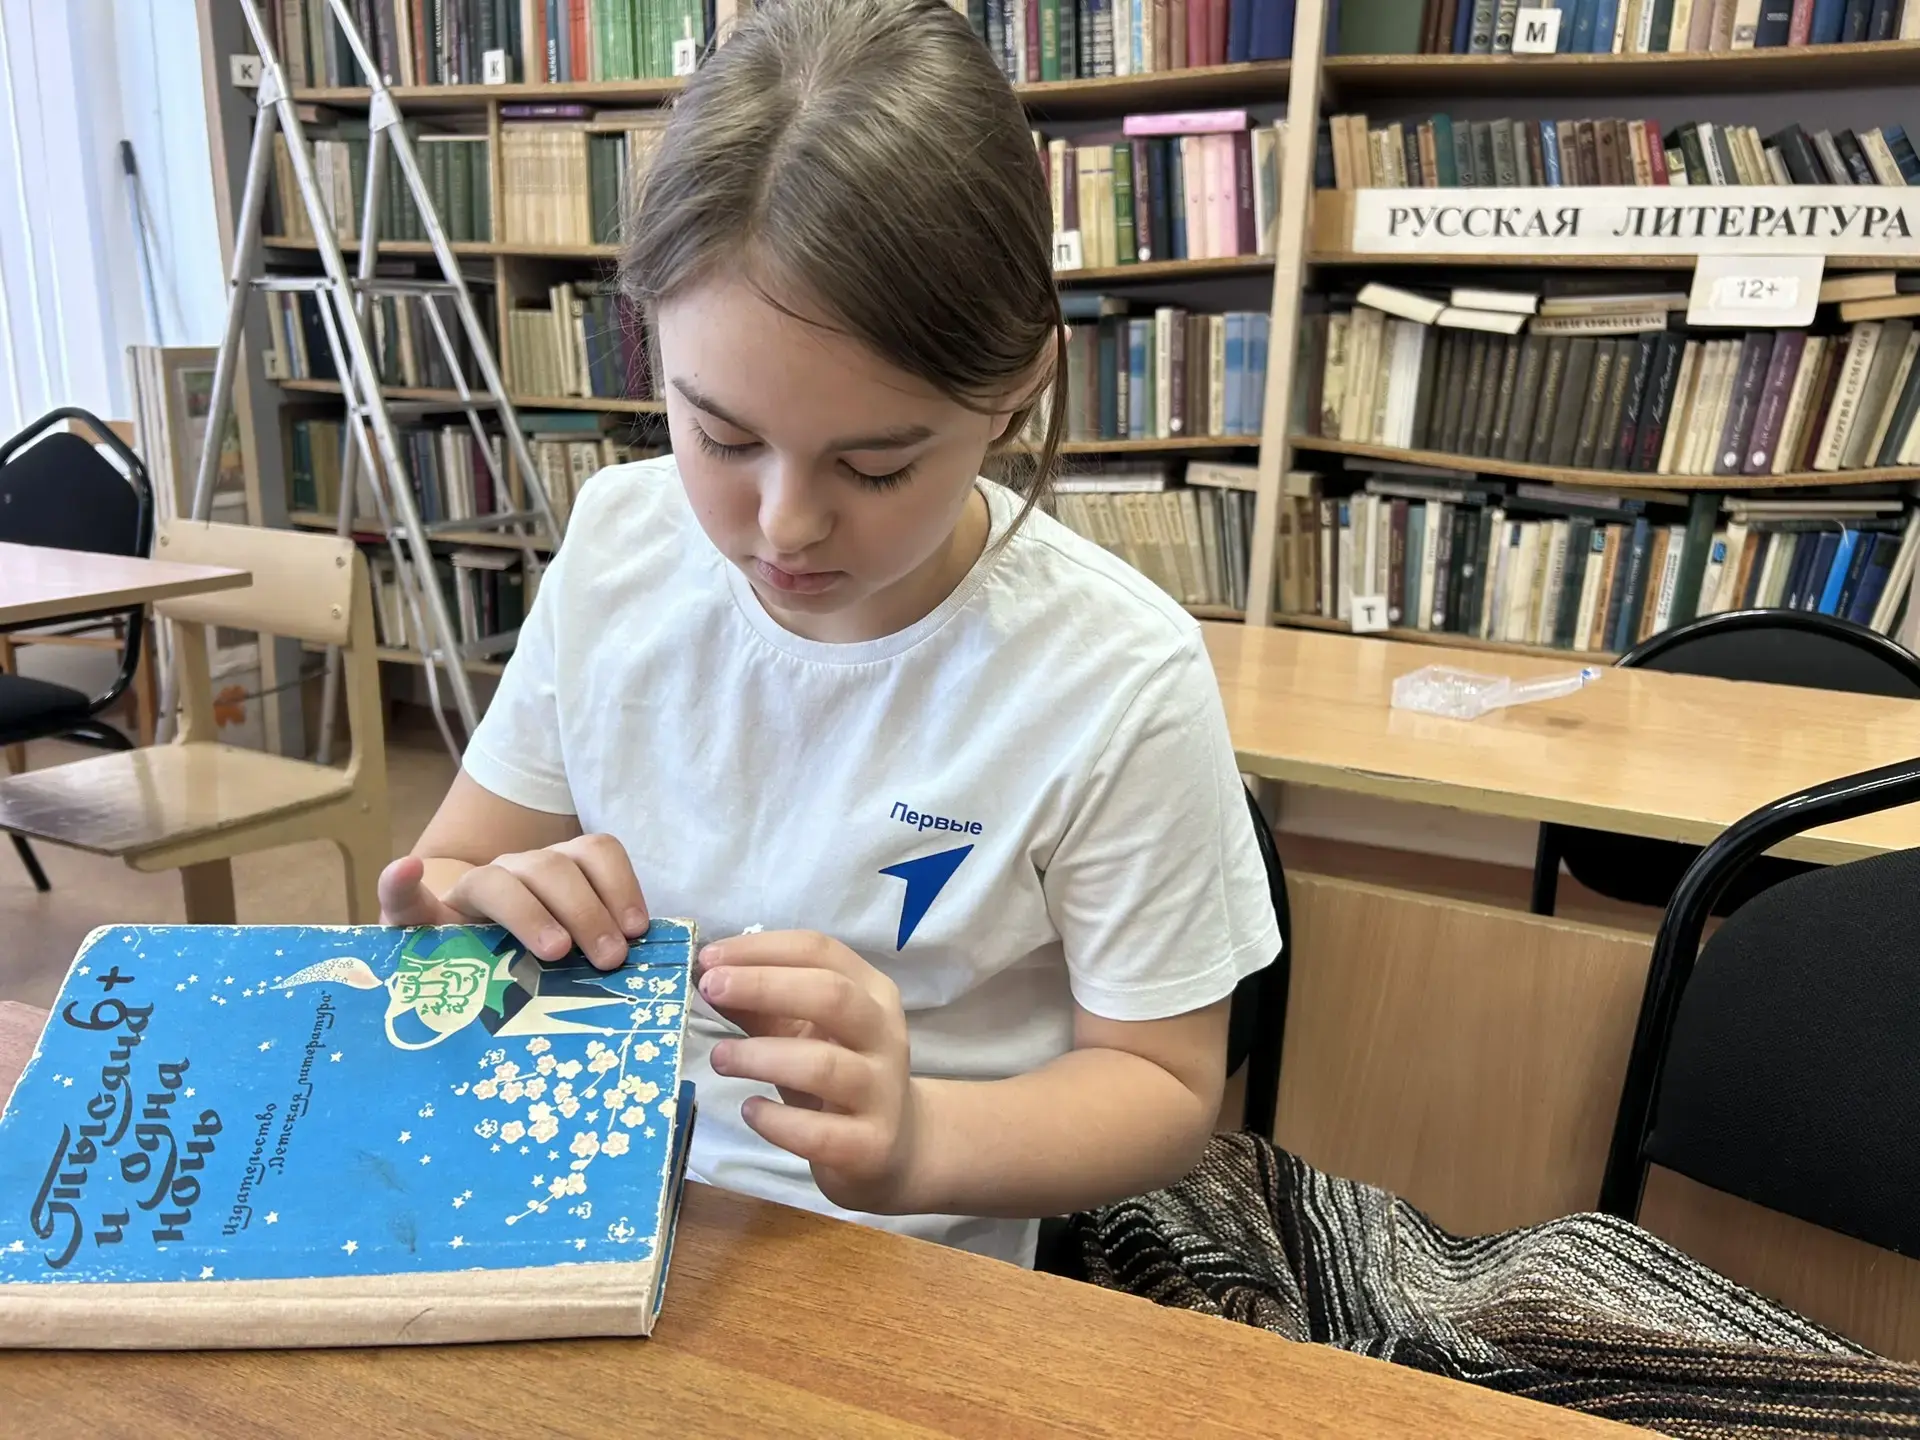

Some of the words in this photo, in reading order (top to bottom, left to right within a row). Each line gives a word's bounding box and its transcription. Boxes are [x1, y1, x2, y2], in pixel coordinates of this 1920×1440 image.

[1525, 21, 1548, 43] М
[1387, 206, 1583, 238] РУССКАЯ
[1612, 205, 1913, 238] ЛИТЕРАТУРА
[1736, 279, 1780, 299] 12+
[889, 801, 983, 835] Первые
[62, 965, 135, 1031] 6+
[30, 1002, 155, 1270] Тысяча
[119, 1056, 191, 1211] одна
[151, 1108, 224, 1244] ночь
